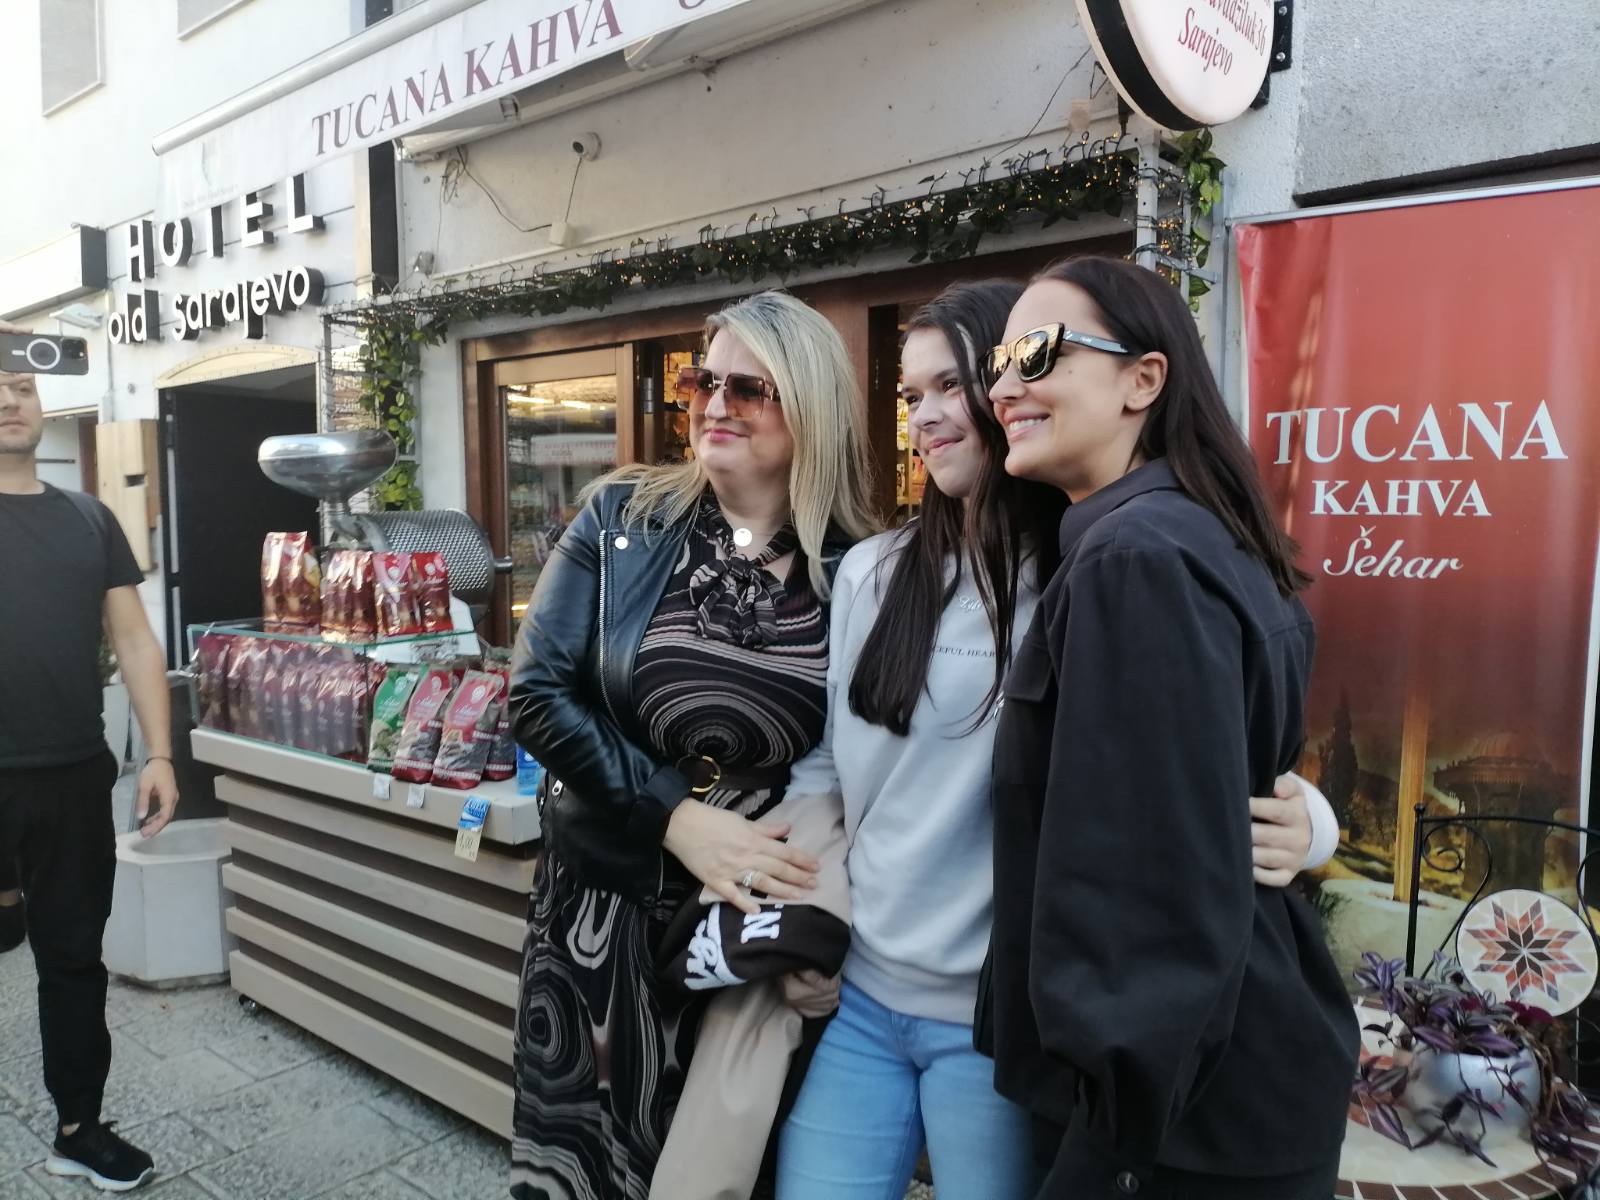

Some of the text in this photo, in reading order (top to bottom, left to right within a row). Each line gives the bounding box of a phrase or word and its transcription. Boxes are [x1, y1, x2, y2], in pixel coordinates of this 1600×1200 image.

[1177, 7, 1234, 76] Sarajevo
[311, 0, 623, 155] TUCANA KAHVA
[107, 288, 160, 345] old
[1266, 399, 1569, 465] TUCANA
[1310, 479, 1492, 516] KAHVA
[1322, 524, 1464, 579] Šehar
